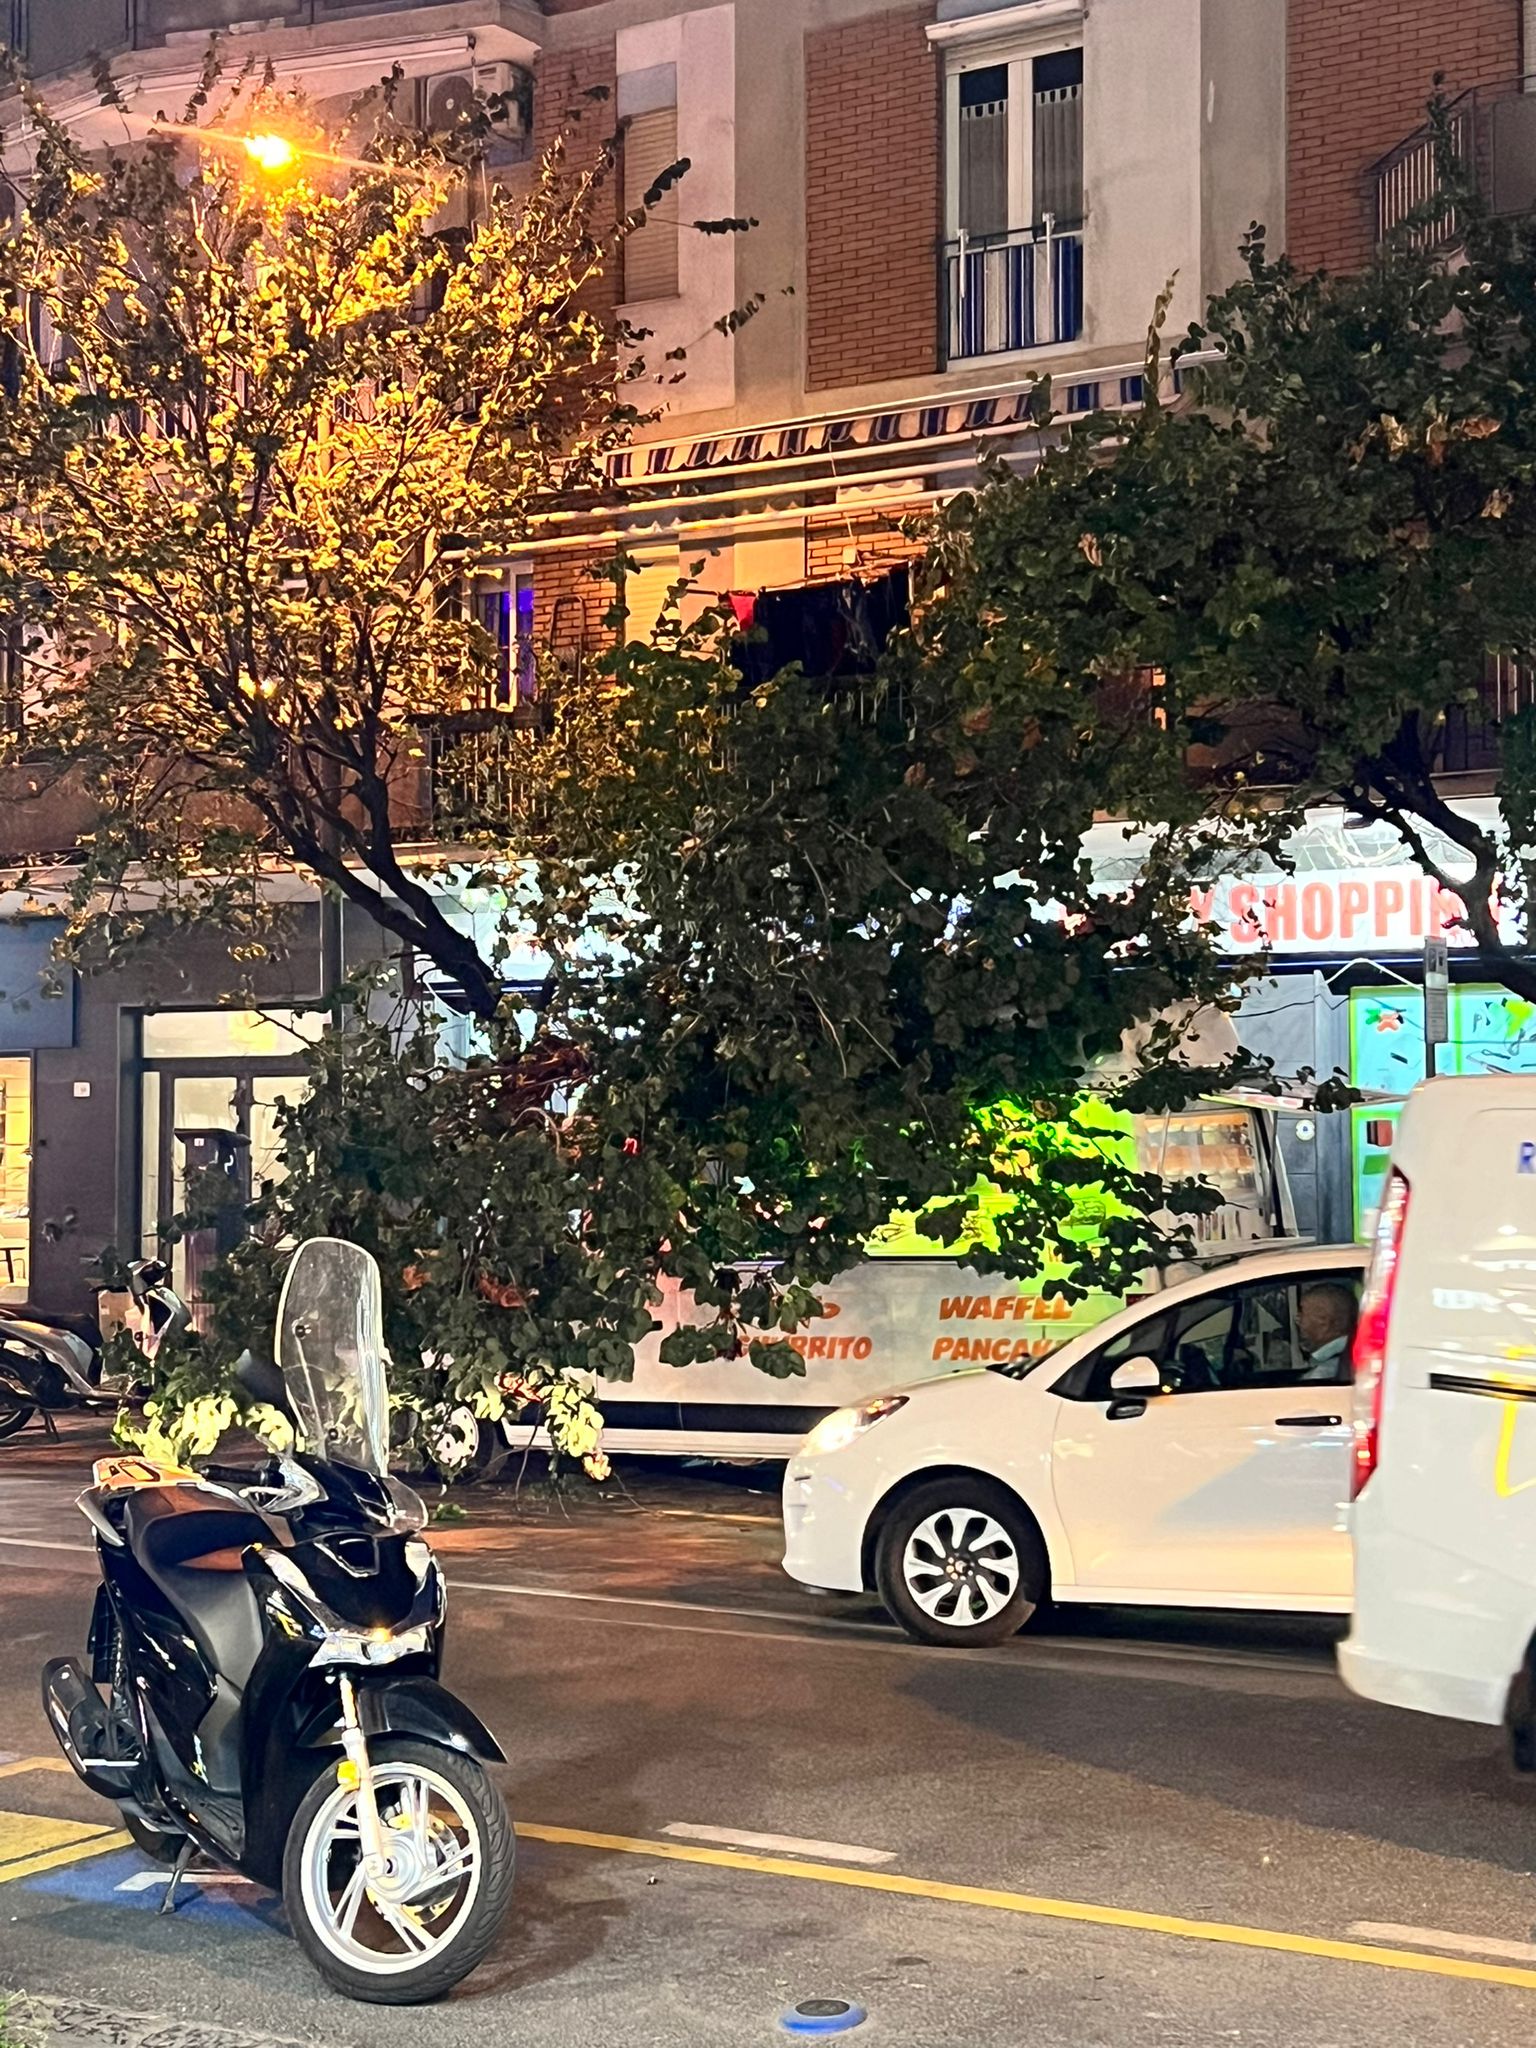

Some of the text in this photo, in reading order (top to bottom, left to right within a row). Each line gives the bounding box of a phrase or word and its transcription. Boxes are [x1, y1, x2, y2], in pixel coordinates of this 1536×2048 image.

[1230, 876, 1500, 944] SHOPPIN
[939, 1295, 1073, 1321] WAFFEL
[932, 1337, 1060, 1362] PANCAK
